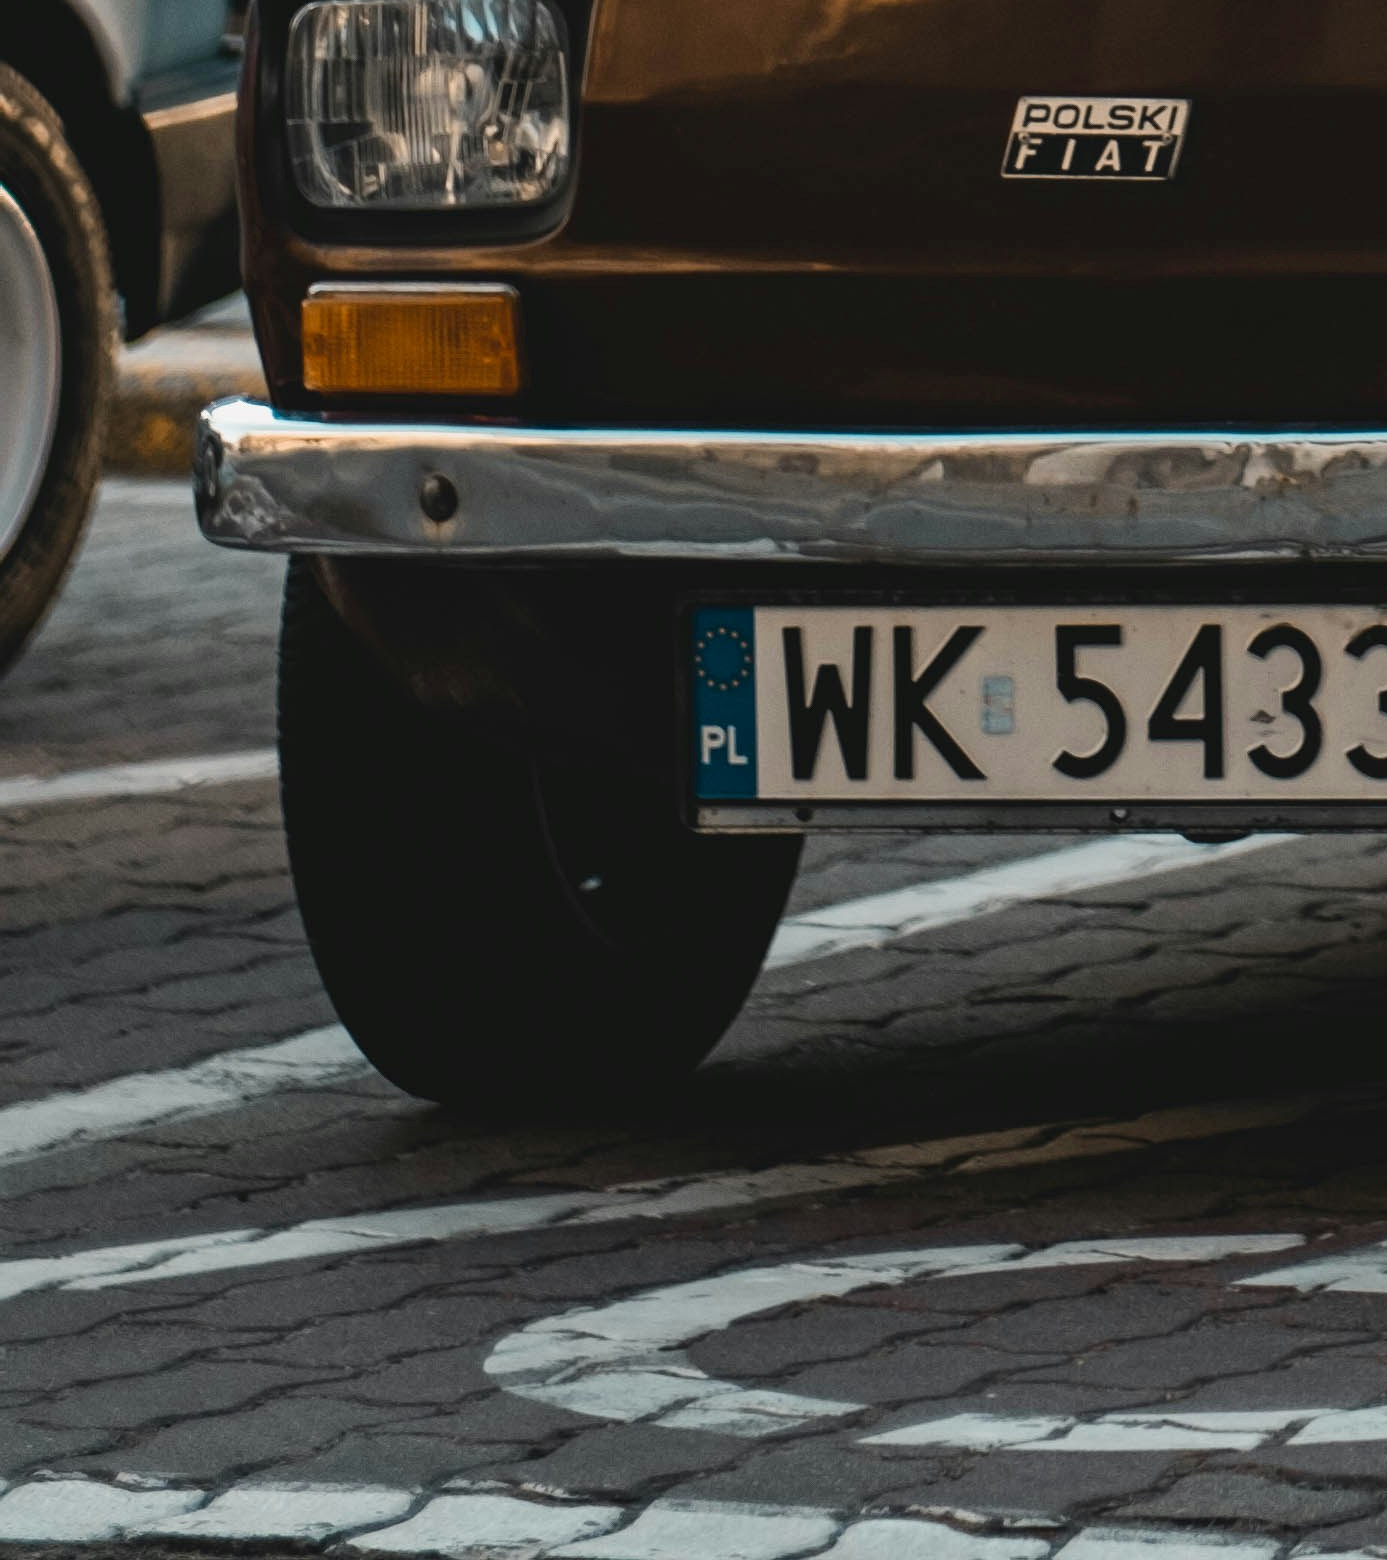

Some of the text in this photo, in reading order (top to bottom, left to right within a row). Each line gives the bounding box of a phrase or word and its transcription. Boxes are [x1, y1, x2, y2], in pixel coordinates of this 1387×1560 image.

[1021, 103, 1179, 132] POLSKI
[1013, 137, 1172, 172] FIAT
[781, 623, 988, 782] WK
[700, 724, 749, 766] PL
